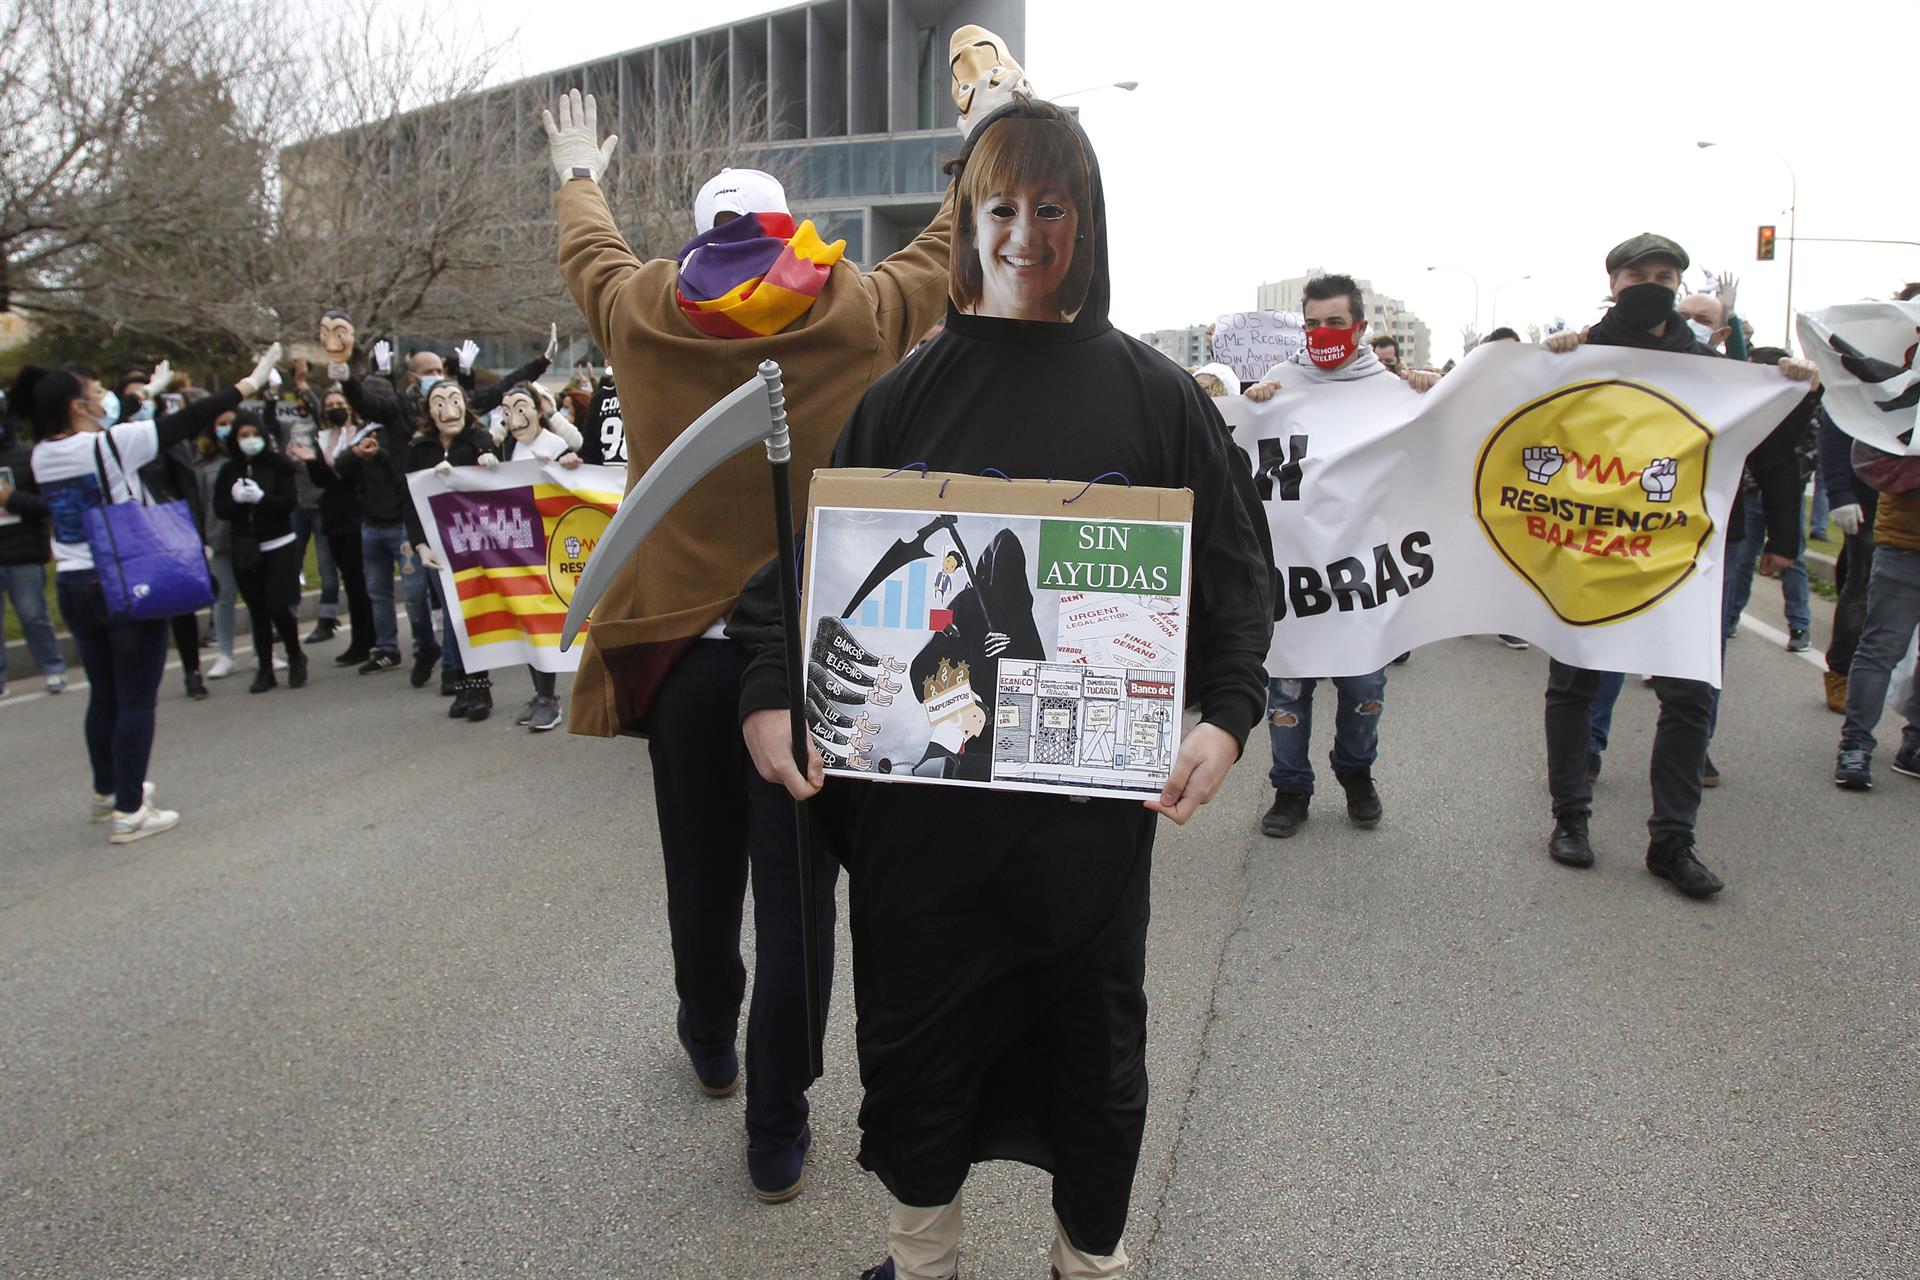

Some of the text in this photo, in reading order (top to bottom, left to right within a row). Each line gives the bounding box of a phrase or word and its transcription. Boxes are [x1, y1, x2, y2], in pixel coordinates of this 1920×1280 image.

[1250, 329, 1297, 347] RECIBES
[1247, 347, 1284, 363] AYUDAS
[1500, 486, 1688, 533] RESISTENCIA
[1079, 525, 1130, 551] SIN
[1526, 515, 1653, 558] BALEAR
[1043, 561, 1168, 590] AYUDAS
[1060, 593, 1084, 604] GENT
[1066, 612, 1129, 629] LEGAL ACTION
[1069, 606, 1120, 622] URGENT
[1148, 614, 1175, 637] ACTION
[834, 636, 866, 660] BANCOS
[1056, 646, 1082, 654] VERDUE
[1113, 638, 1157, 659] DEMAND
[1124, 633, 1153, 649] FINAL
[826, 652, 863, 680] TELÉFONO
[826, 681, 842, 696] GAS
[1131, 683, 1157, 694] Banco
[1158, 685, 1169, 695] de
[928, 692, 970, 712] IMPUESTOS
[824, 706, 840, 722] LUZ
[813, 721, 835, 741] AGUA
